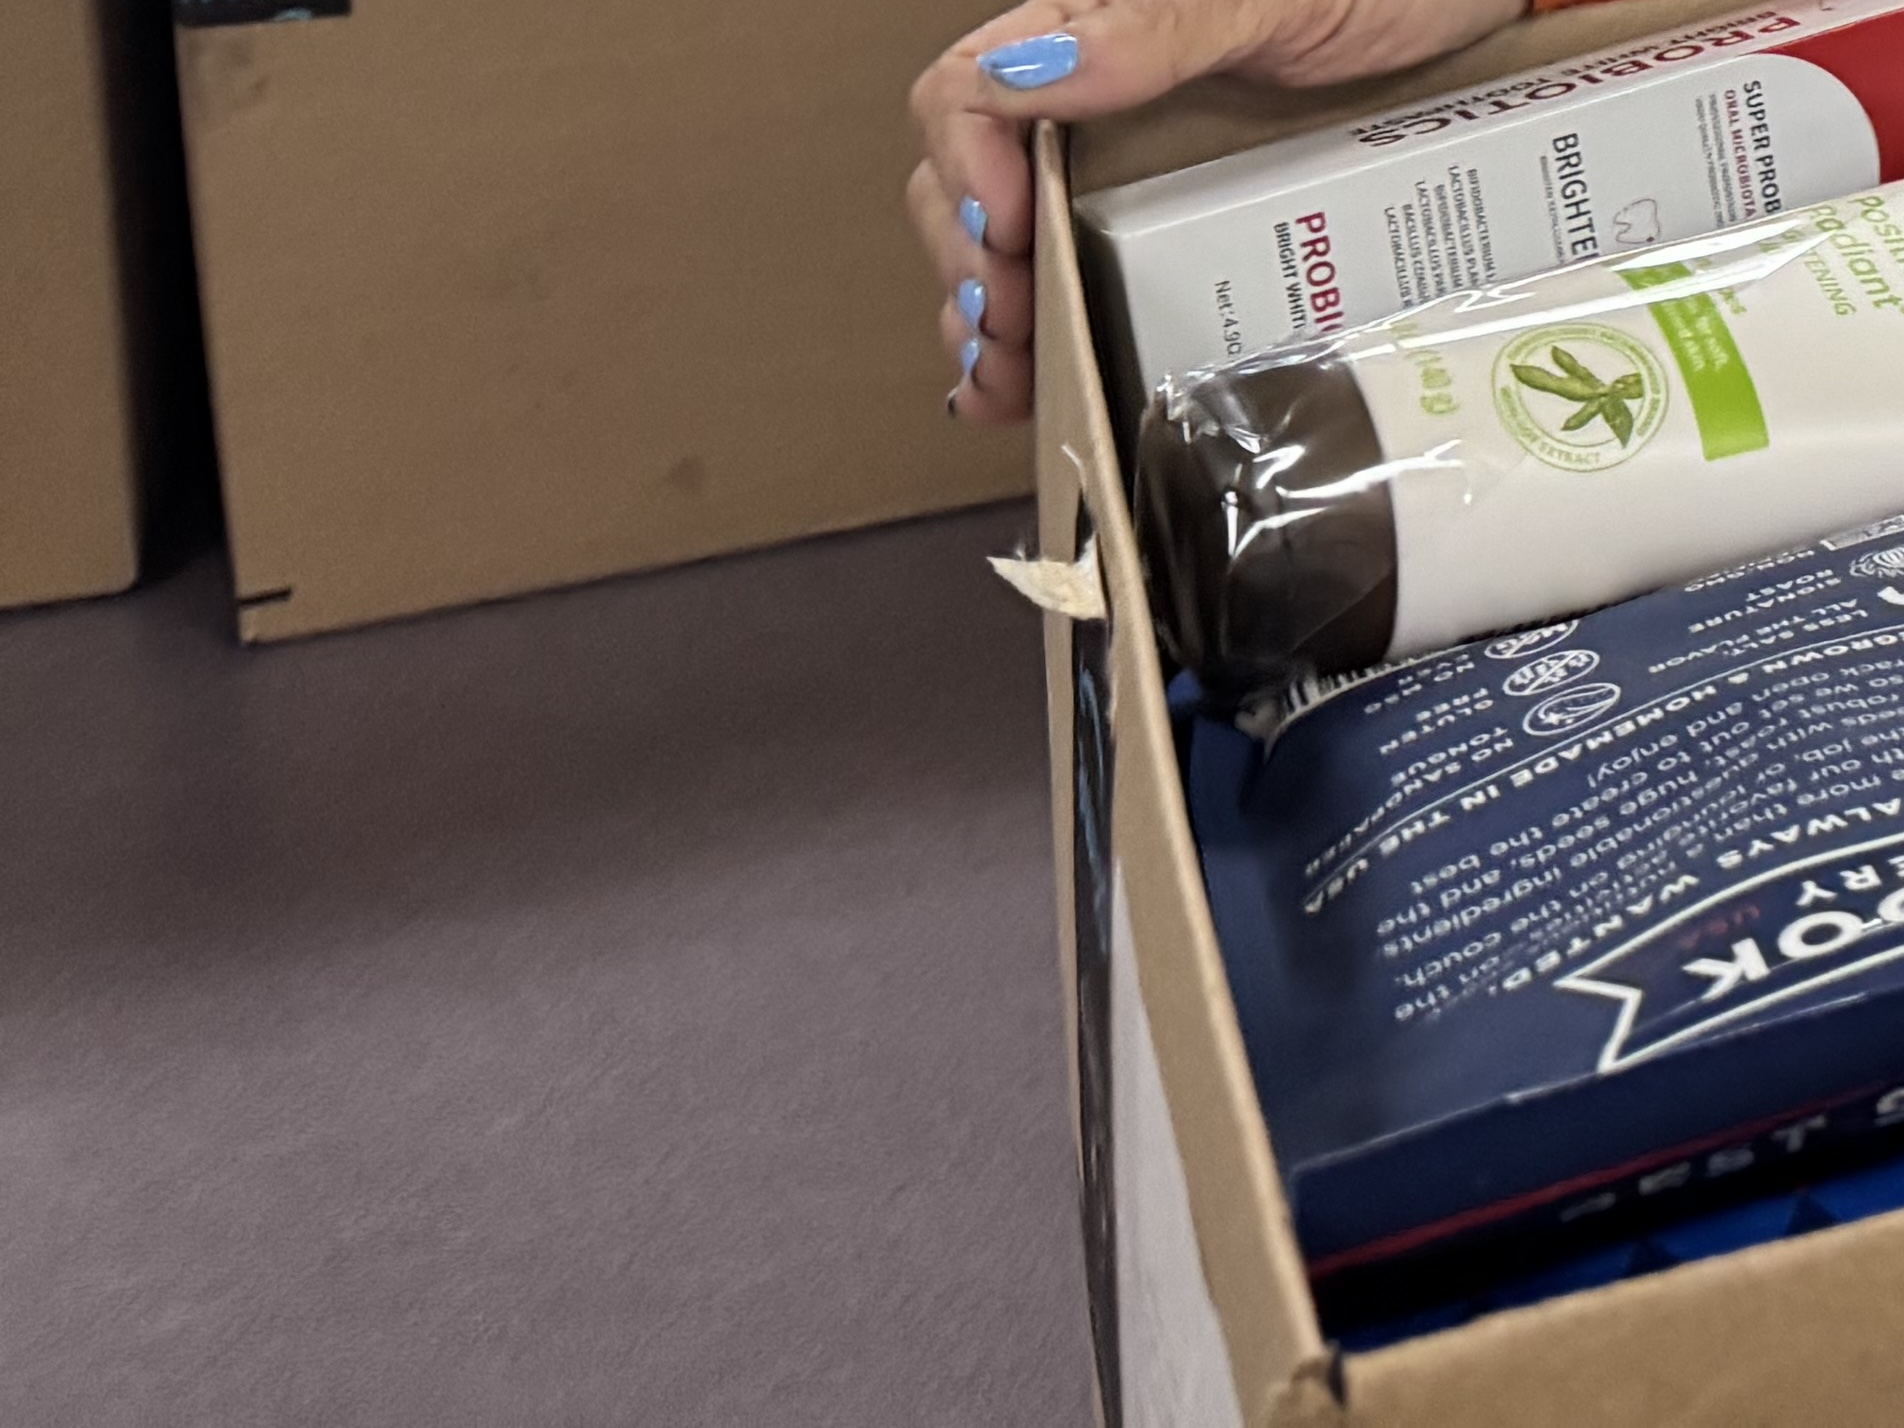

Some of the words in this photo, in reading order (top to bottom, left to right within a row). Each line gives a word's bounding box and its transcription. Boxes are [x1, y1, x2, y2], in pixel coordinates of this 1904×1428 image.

[1360, 17, 1800, 147] PROBIOTICS
[1743, 80, 1772, 149] SUPER
[1552, 132, 1601, 263] BRIGHTE
[1274, 221, 1299, 279] BRIGHT
[1296, 211, 1345, 333] PROBI
[1687, 576, 1841, 634] SIGNATURE
[1744, 569, 1834, 603] ROAST
[1755, 614, 1806, 637] THE
[1802, 608, 1869, 633] LESS
[1810, 598, 1858, 617] ALL
[1647, 633, 1751, 674] FLAVOR
[1414, 687, 1489, 723] FREE
[1751, 671, 1830, 703] open
[1797, 693, 1900, 720] robust
[1378, 699, 1494, 755] GLUTEN
[1509, 684, 1717, 788] HOMEMADE
[1686, 702, 1743, 738] and
[1766, 721, 1834, 751] with
[1390, 726, 1509, 786] TONGUE
[1470, 737, 1515, 763] NO
[1586, 733, 1679, 789] enjoy!
[1808, 758, 1862, 782] our
[1459, 783, 1501, 812] IN
[1551, 771, 1649, 828] create
[1619, 769, 1699, 816] huge
[1796, 773, 1882, 806] more
[1378, 810, 1452, 857] THE
[1713, 802, 1788, 842] than
[1715, 798, 1902, 869] ALWAYS
[1409, 854, 1481, 896] best
[1439, 869, 1501, 908] and
[1383, 865, 1561, 958] ingredients
